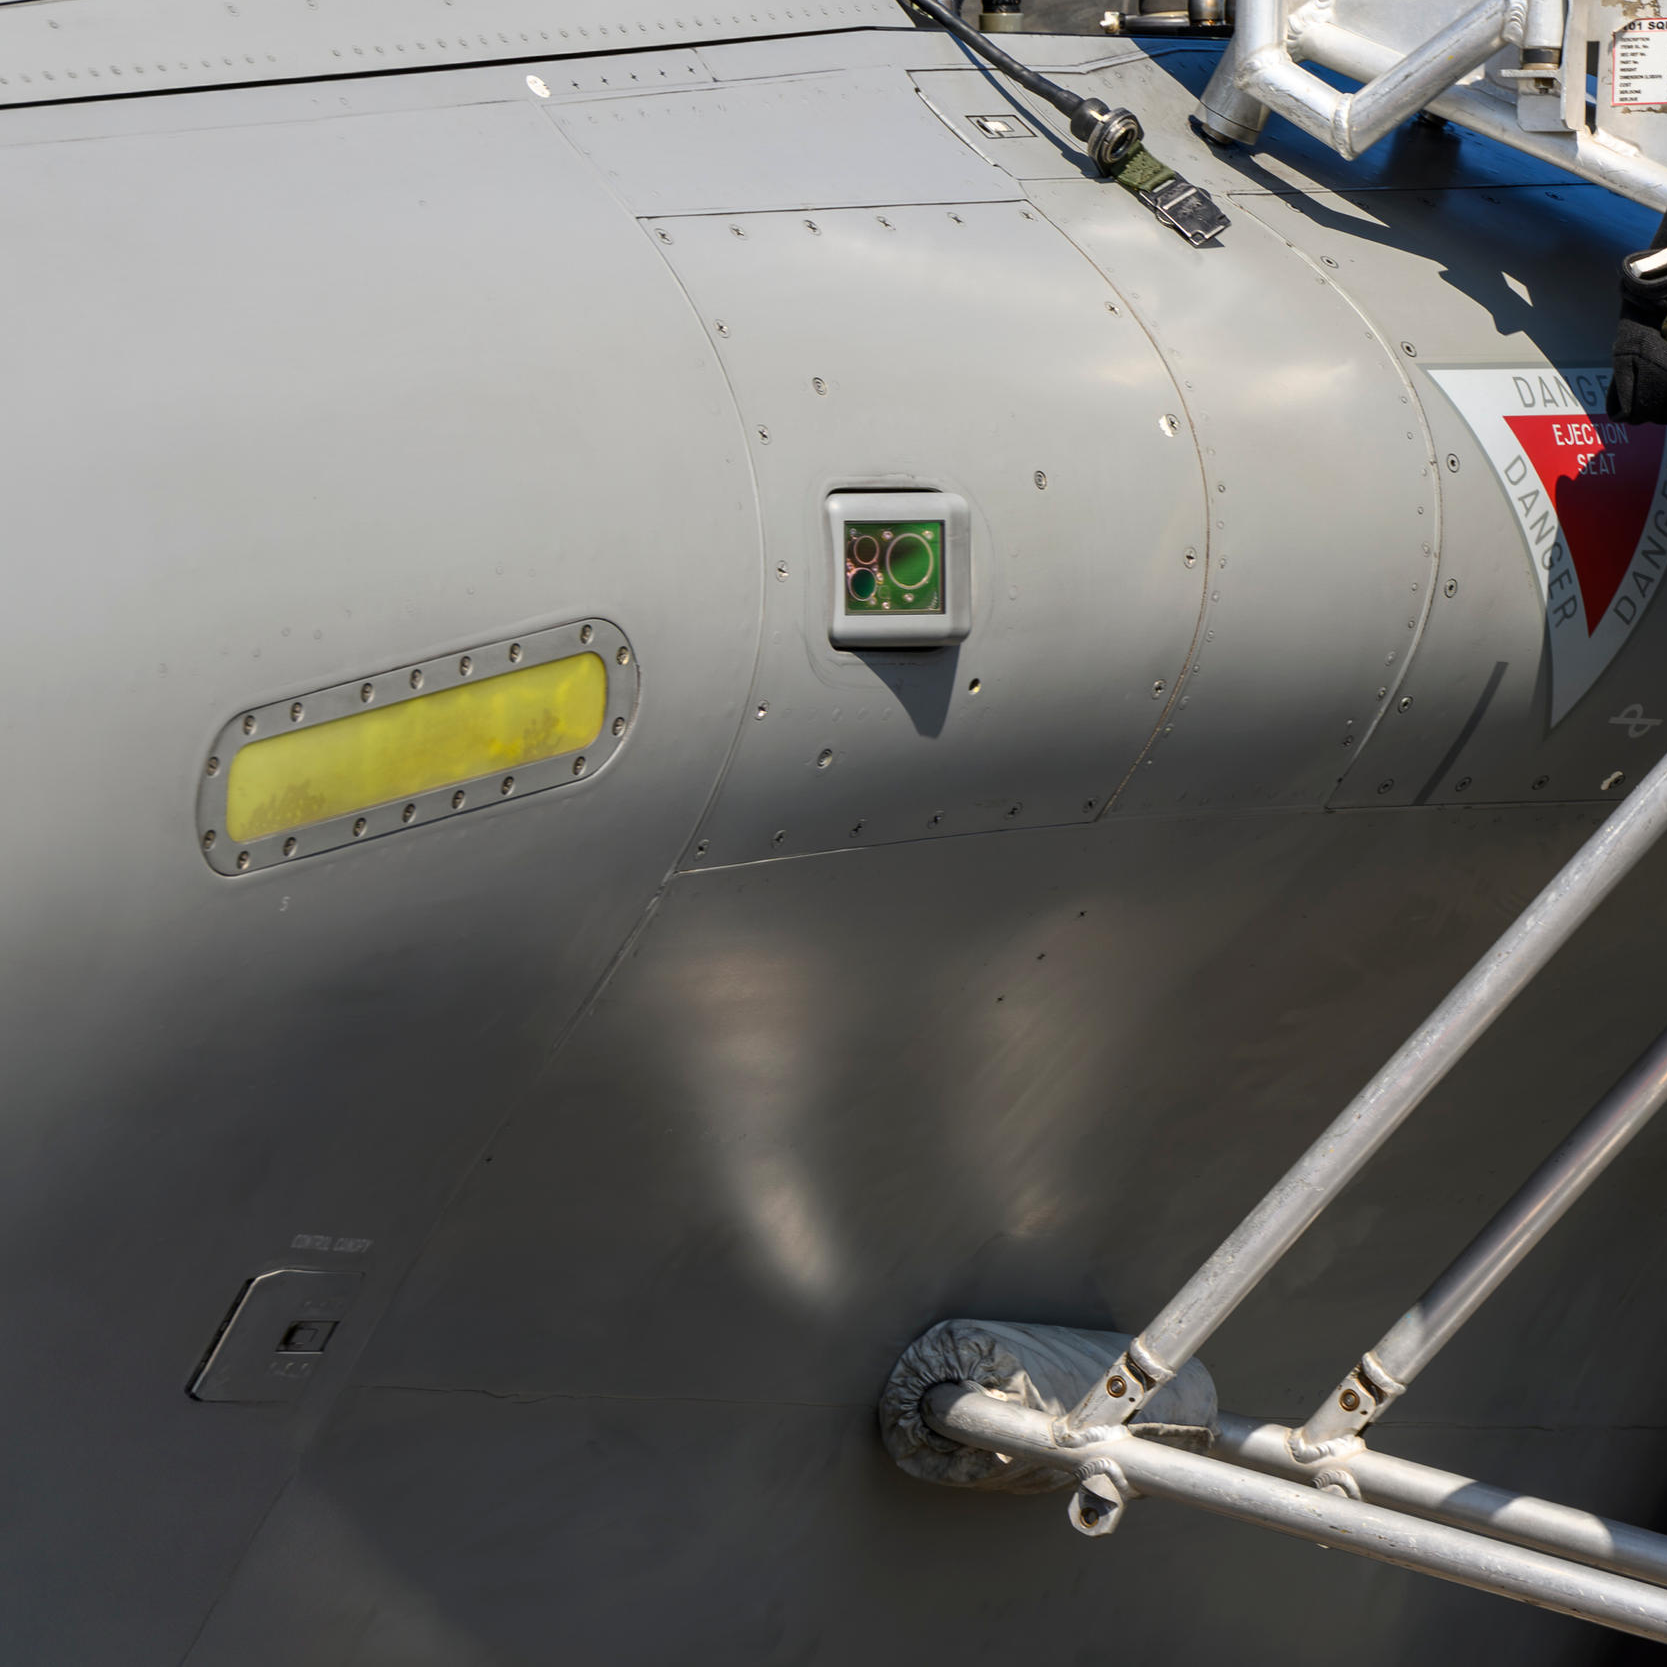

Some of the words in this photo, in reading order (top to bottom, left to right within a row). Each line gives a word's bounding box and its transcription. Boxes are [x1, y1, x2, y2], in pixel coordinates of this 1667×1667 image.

[1552, 422, 1629, 446] EJECTION
[1577, 453, 1616, 475] SEAT
[1504, 455, 1578, 628] DANGER
